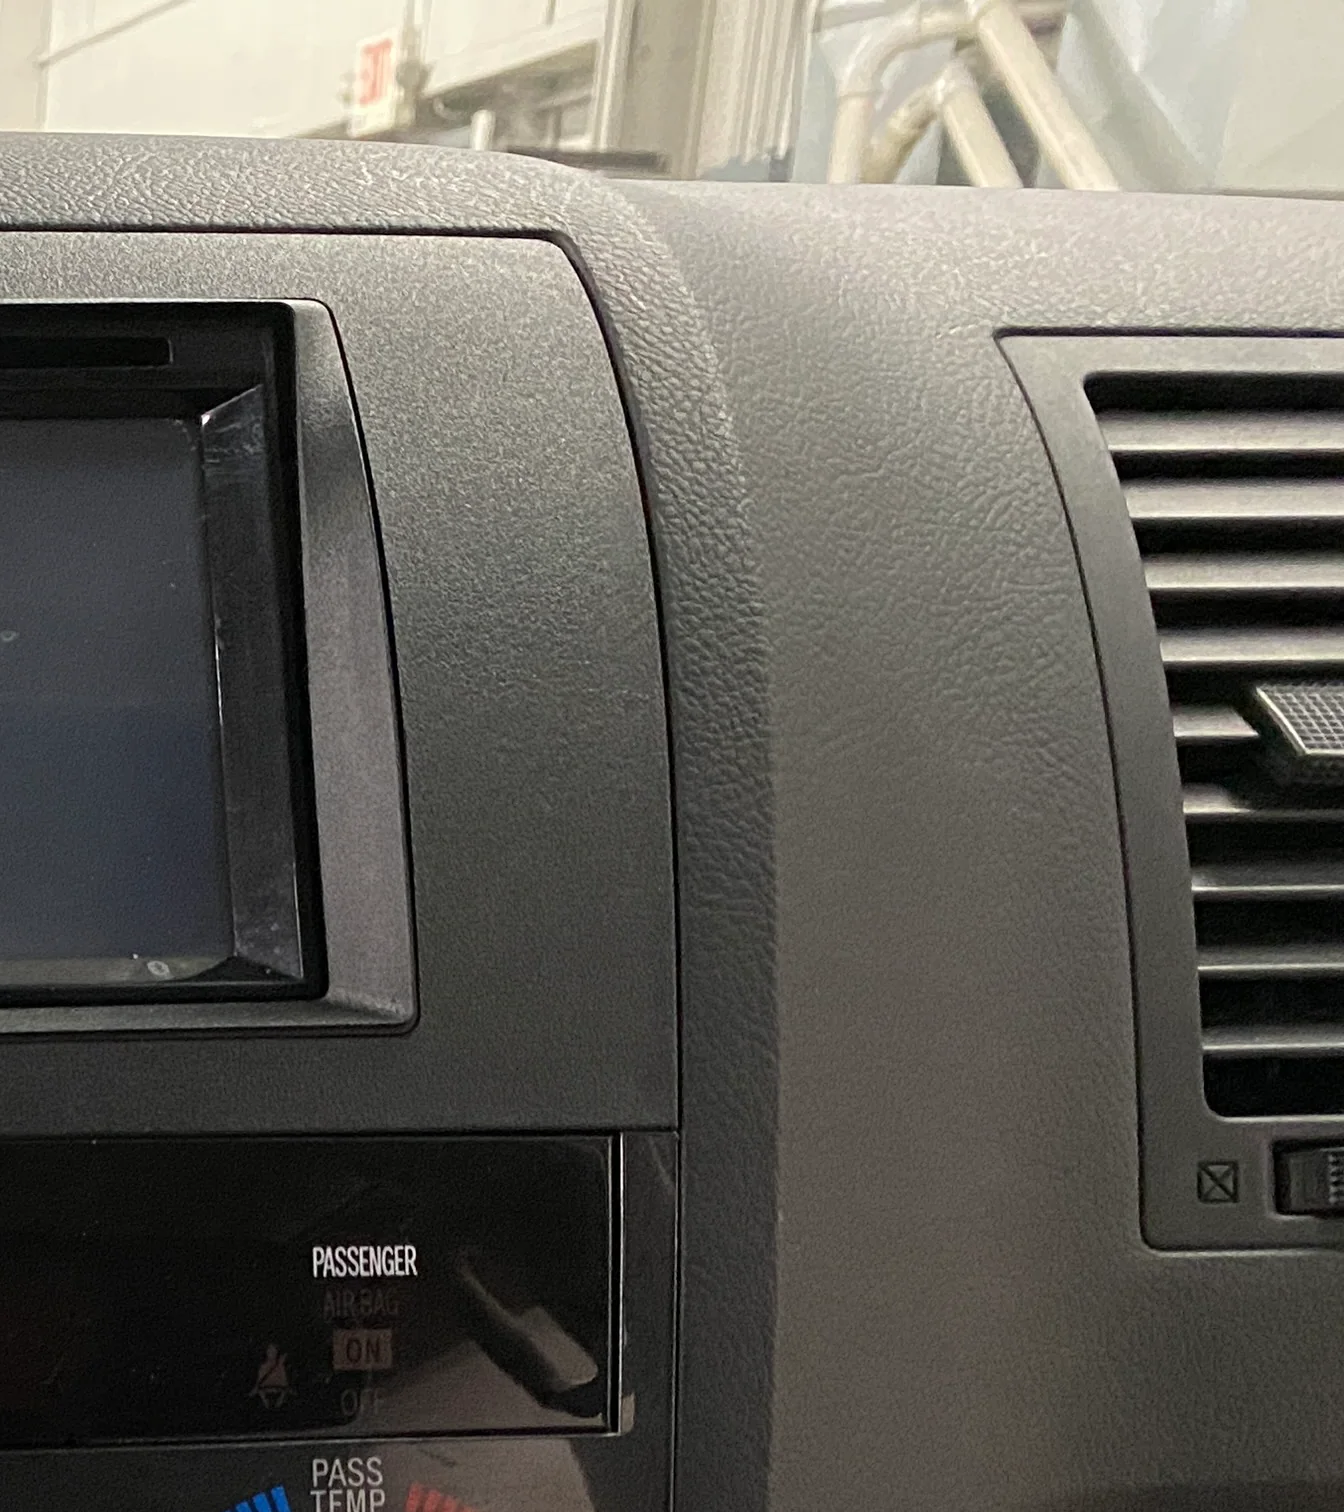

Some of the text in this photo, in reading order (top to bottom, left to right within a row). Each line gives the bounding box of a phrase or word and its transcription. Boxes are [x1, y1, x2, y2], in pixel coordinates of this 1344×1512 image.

[312, 1245, 418, 1277] PASSENGER
[345, 1337, 381, 1365] ON
[312, 1456, 384, 1487] PASS
